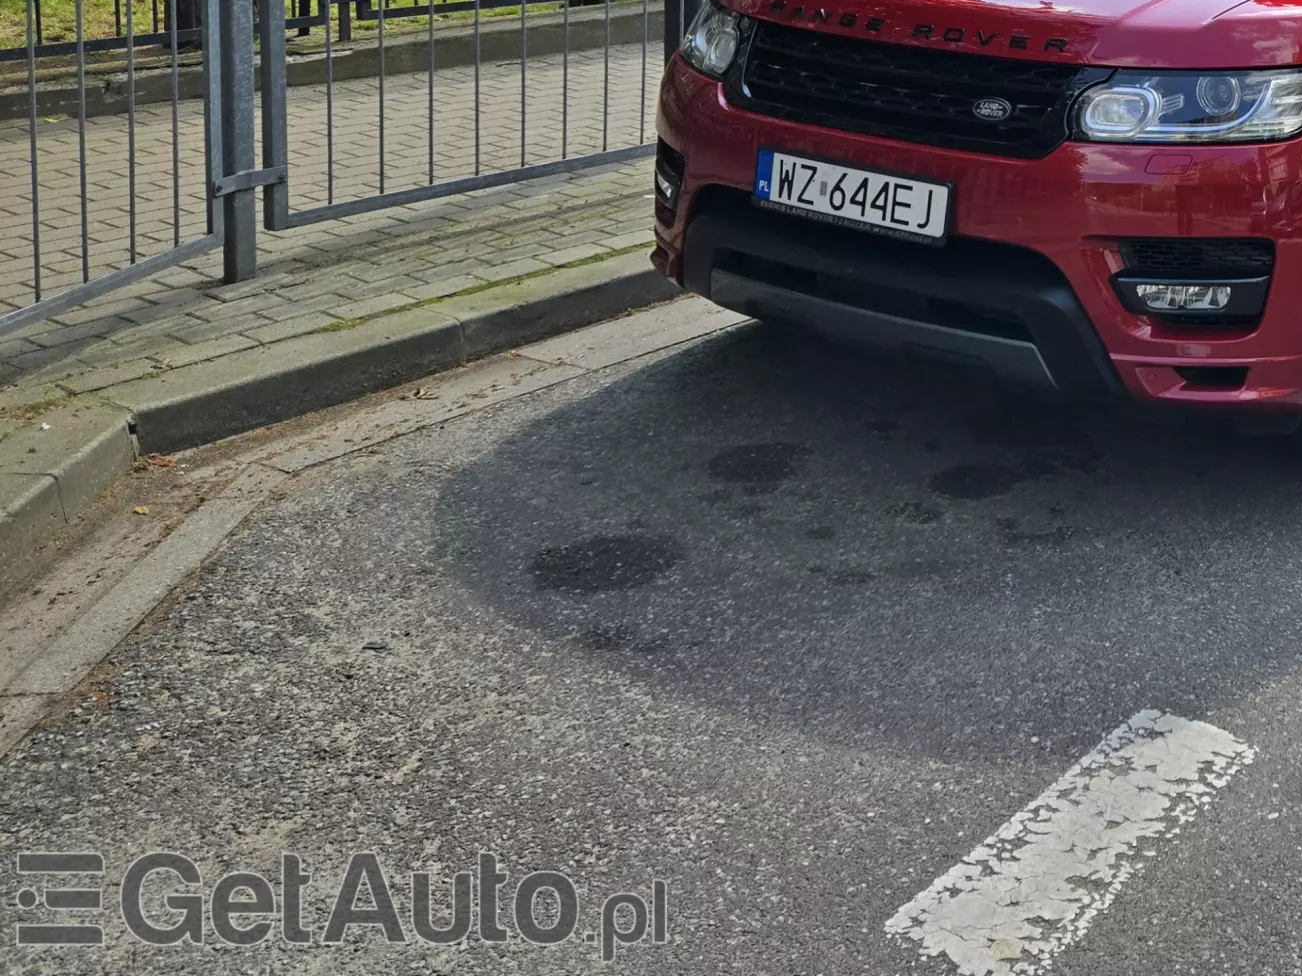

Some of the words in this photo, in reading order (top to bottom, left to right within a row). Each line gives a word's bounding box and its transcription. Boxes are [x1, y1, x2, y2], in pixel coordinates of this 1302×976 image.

[769, 0, 885, 33] RANGE
[912, 23, 1068, 54] ROVER
[758, 179, 770, 192] PL
[778, 159, 818, 206] WZ
[828, 172, 934, 230] 644EJ
[786, 206, 807, 217] LAND
